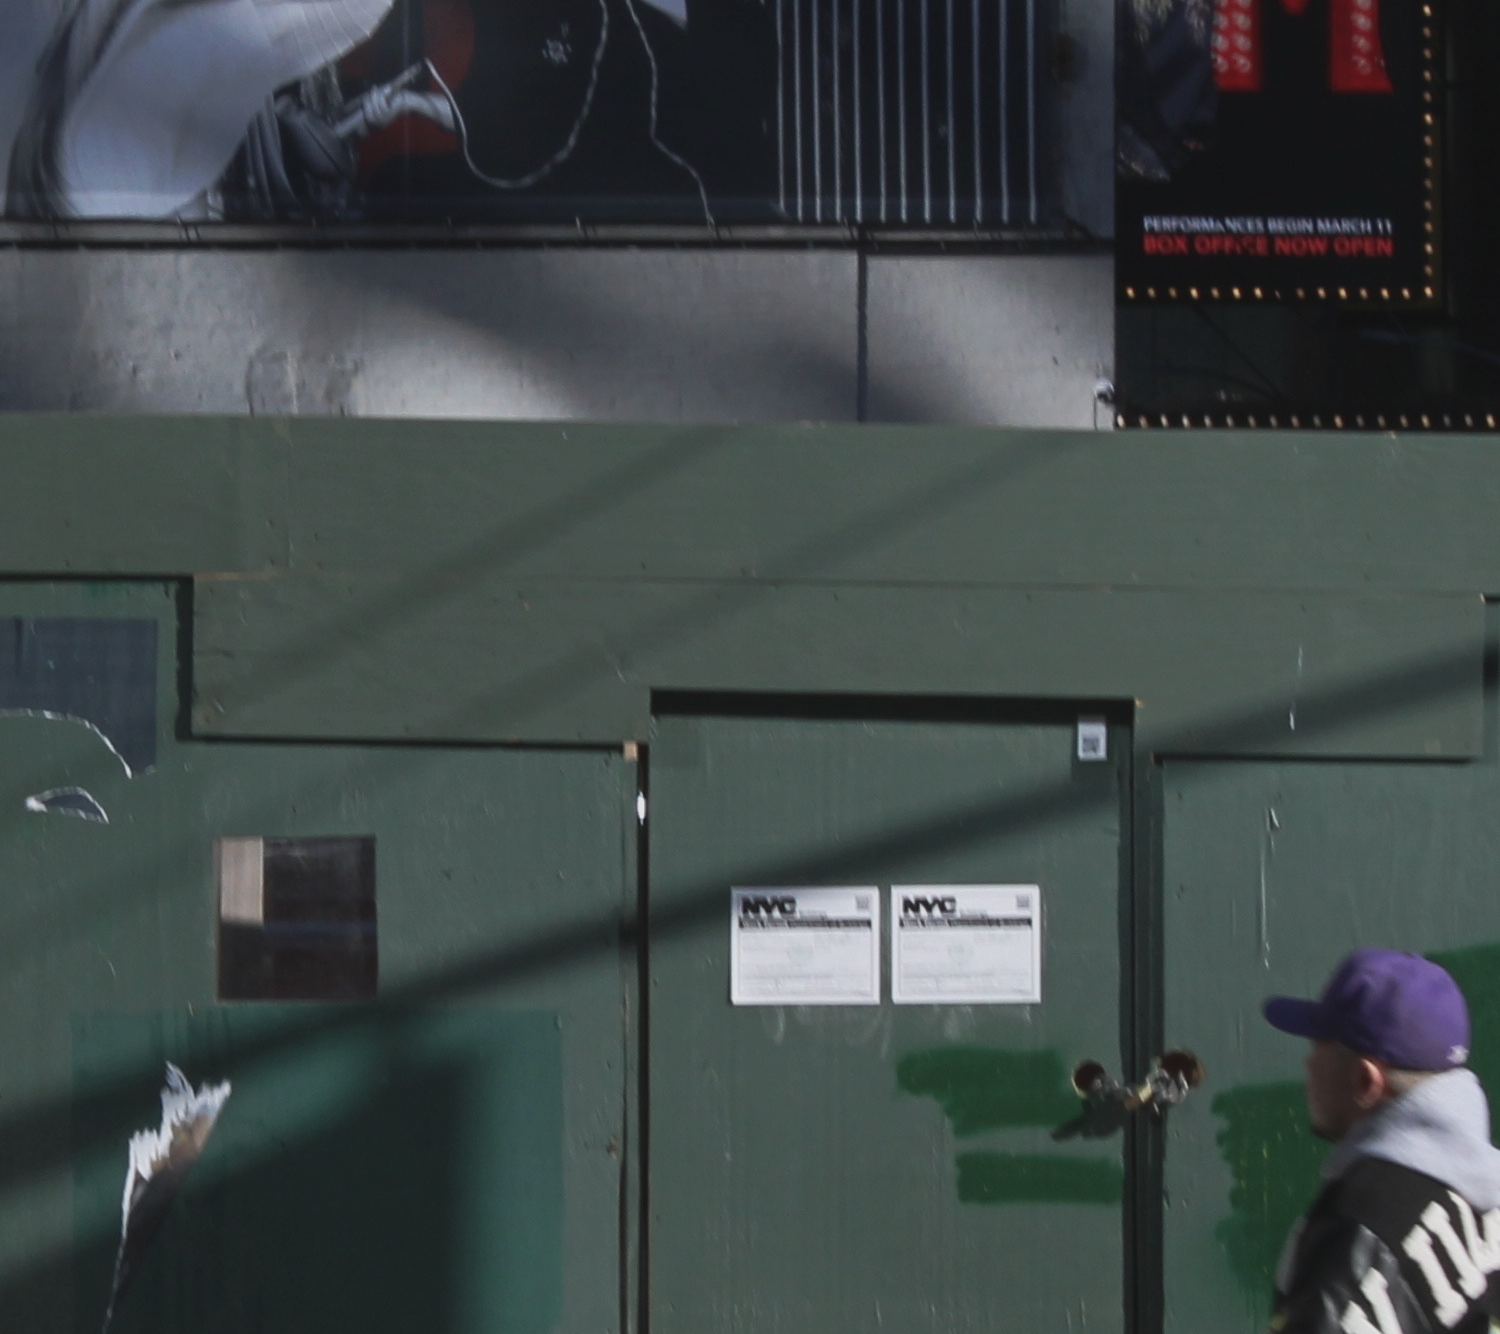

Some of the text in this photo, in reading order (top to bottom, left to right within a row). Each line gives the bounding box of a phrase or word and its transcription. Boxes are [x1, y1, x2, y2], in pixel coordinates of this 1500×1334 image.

[1143, 216, 1265, 234] PERFORMANCES
[1267, 217, 1314, 234] BEGIN
[1317, 217, 1371, 234] MARCH
[1143, 233, 1396, 257] BOX OFFICE NOW OPEN
[740, 896, 797, 917] NYC
[901, 896, 957, 917] NYC
